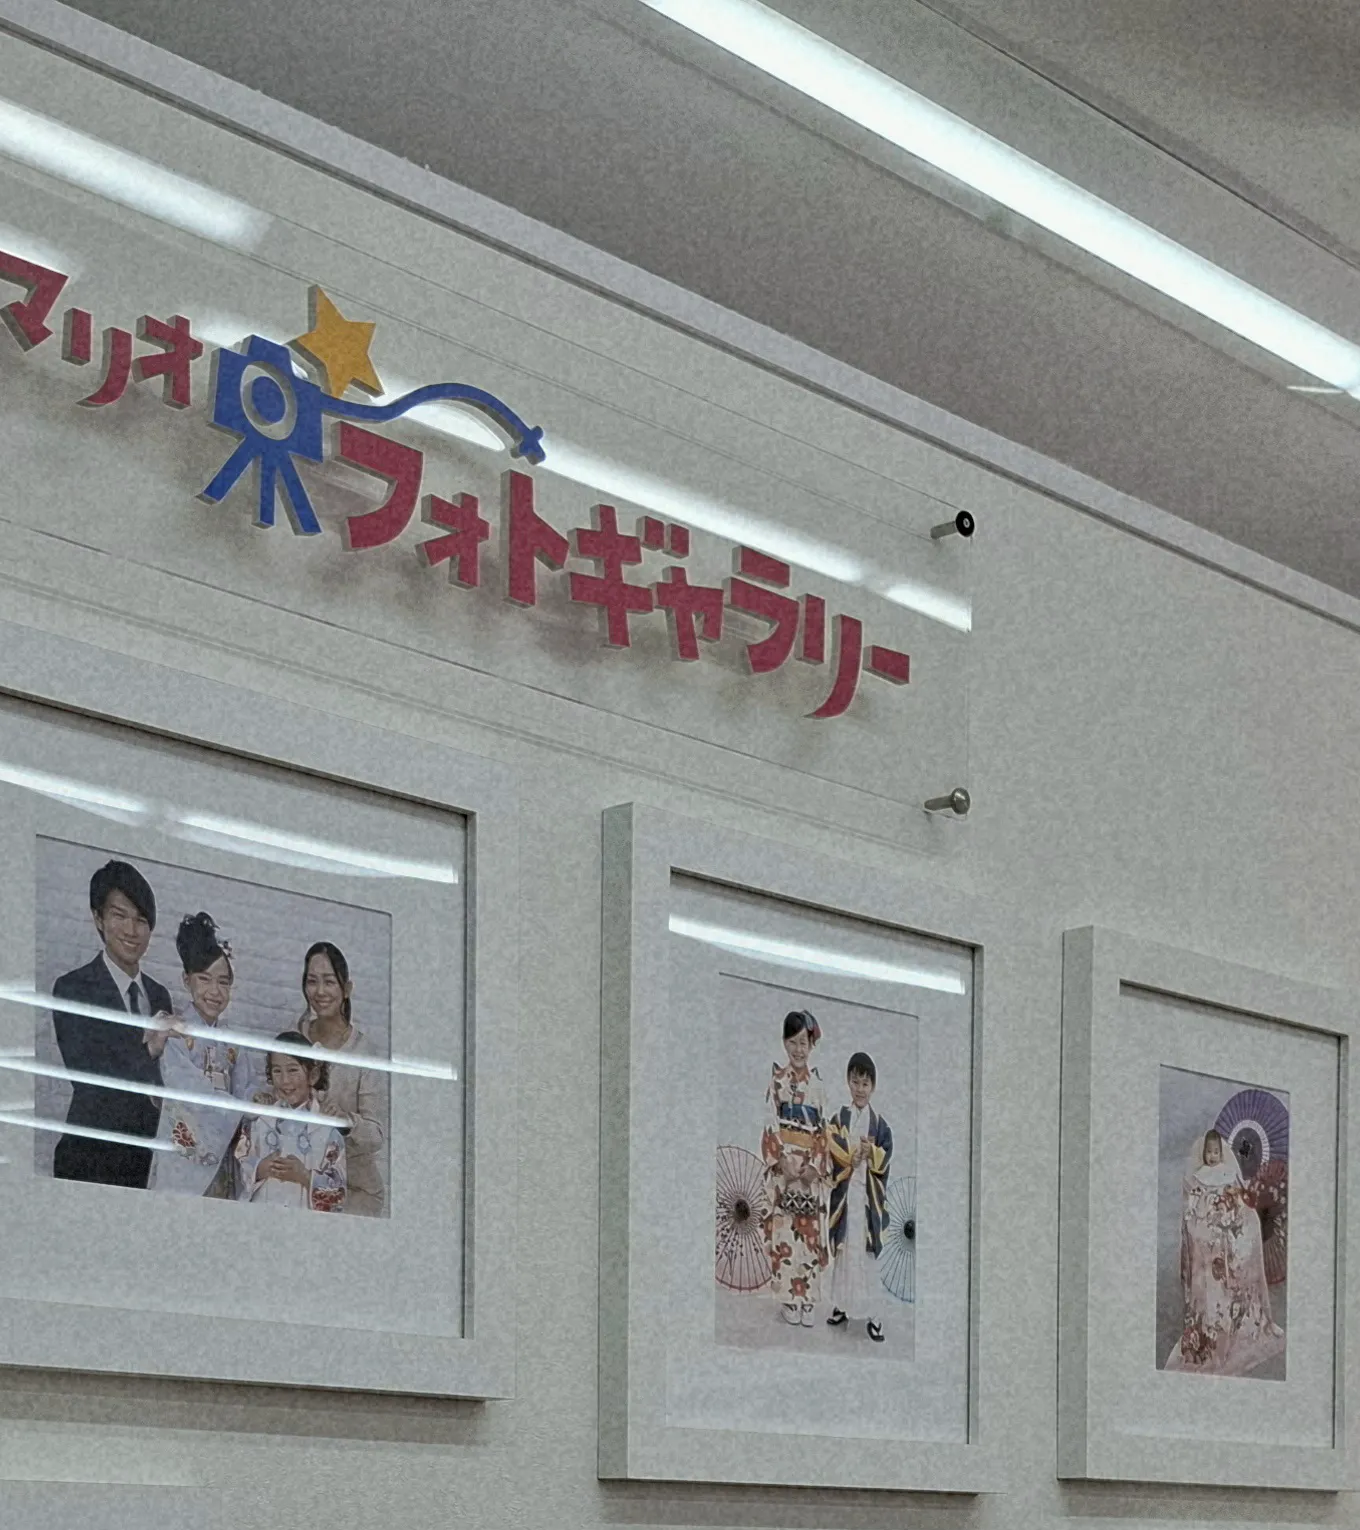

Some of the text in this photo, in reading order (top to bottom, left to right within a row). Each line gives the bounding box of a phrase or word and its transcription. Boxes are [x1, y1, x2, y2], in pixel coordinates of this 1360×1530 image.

[335, 419, 911, 720] フォトギャラリー
